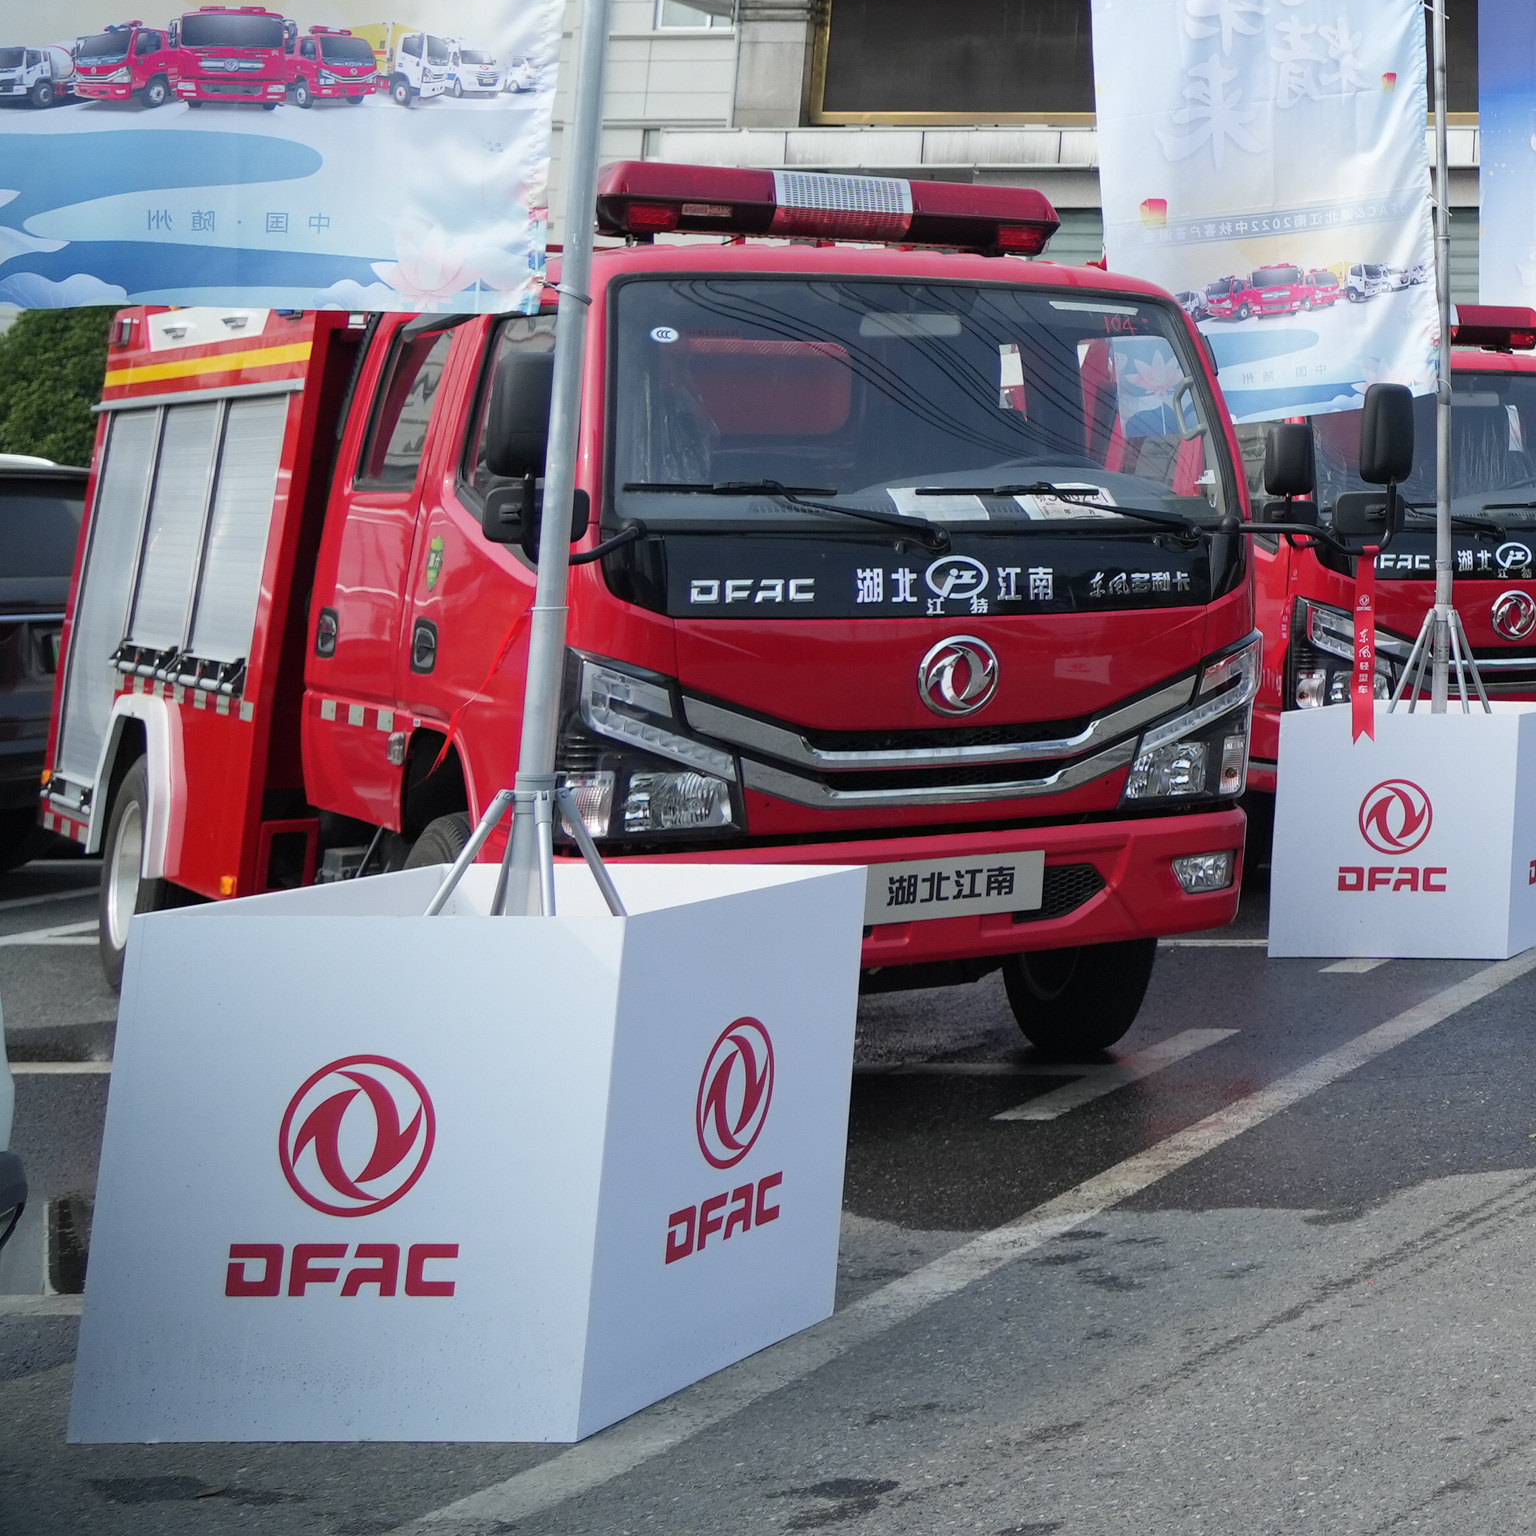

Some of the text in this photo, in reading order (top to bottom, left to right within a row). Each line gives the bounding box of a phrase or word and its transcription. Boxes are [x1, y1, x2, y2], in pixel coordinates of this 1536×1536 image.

[1374, 554, 1431, 571] FAC
[1457, 549, 1493, 573] 湖北
[690, 577, 816, 605] DFAC
[855, 567, 918, 603] 湖北
[996, 566, 1054, 601] 江南
[886, 865, 1015, 908] 湖北江南
[1337, 866, 1448, 893] DFAC
[664, 1170, 783, 1265] DFAC
[224, 1242, 460, 1298] DFAC
